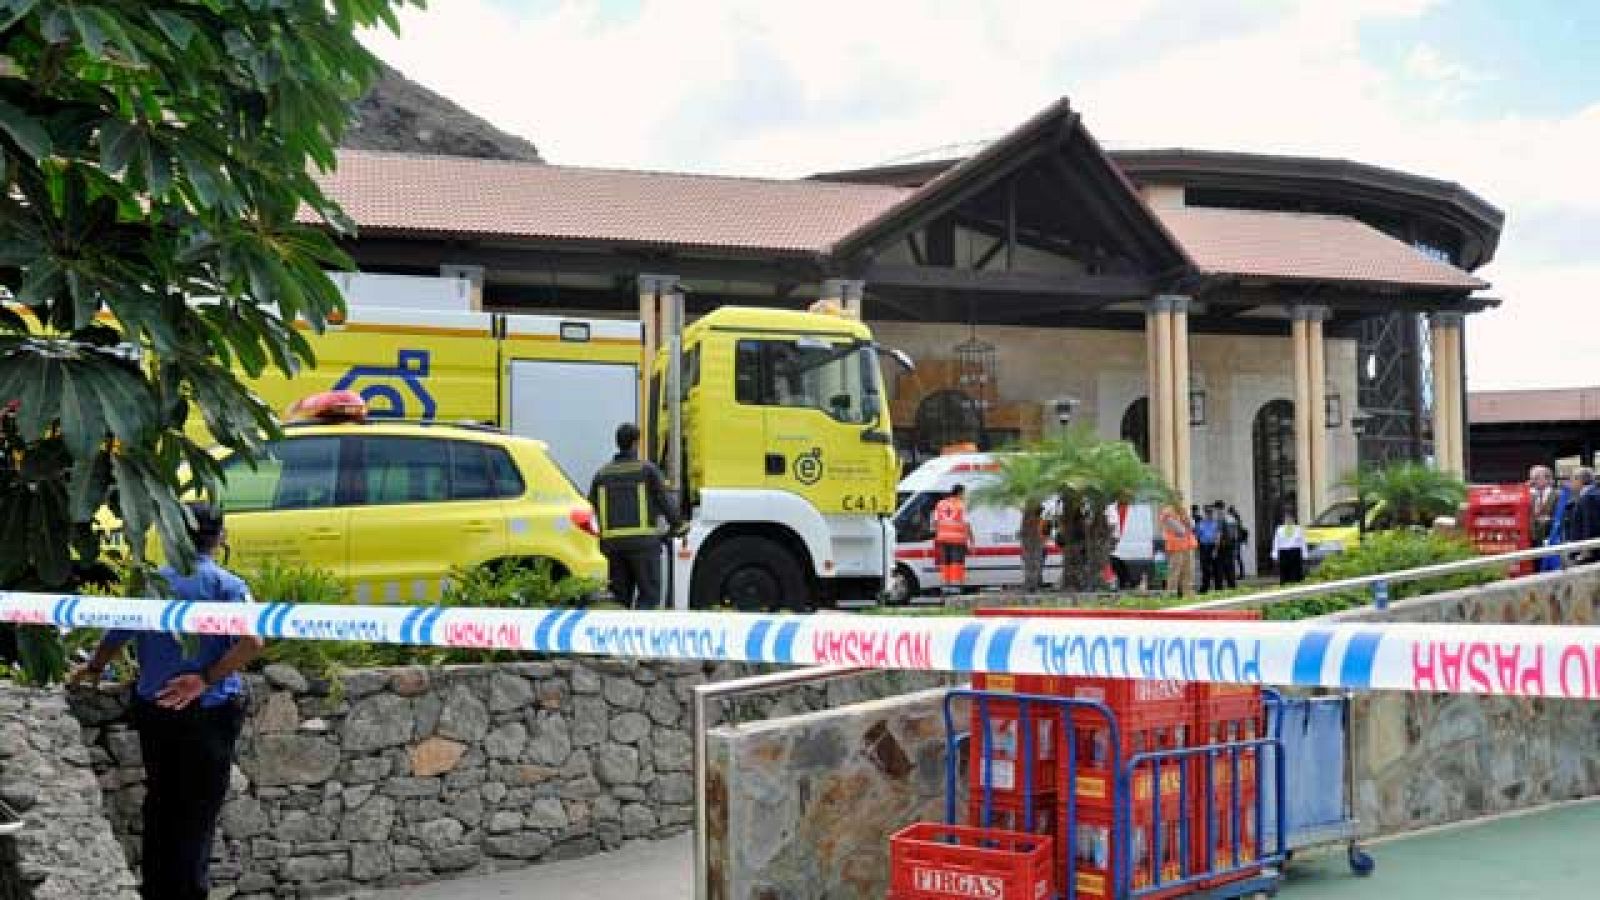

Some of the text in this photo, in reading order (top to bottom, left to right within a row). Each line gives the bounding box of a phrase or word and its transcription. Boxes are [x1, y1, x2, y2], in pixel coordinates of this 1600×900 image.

[812, 627, 931, 669] NO PASAR
[1034, 634, 1261, 682] POLICIA LOCAL
[1411, 639, 1546, 697] PASAR
[914, 867, 1004, 899] FIRGAS
